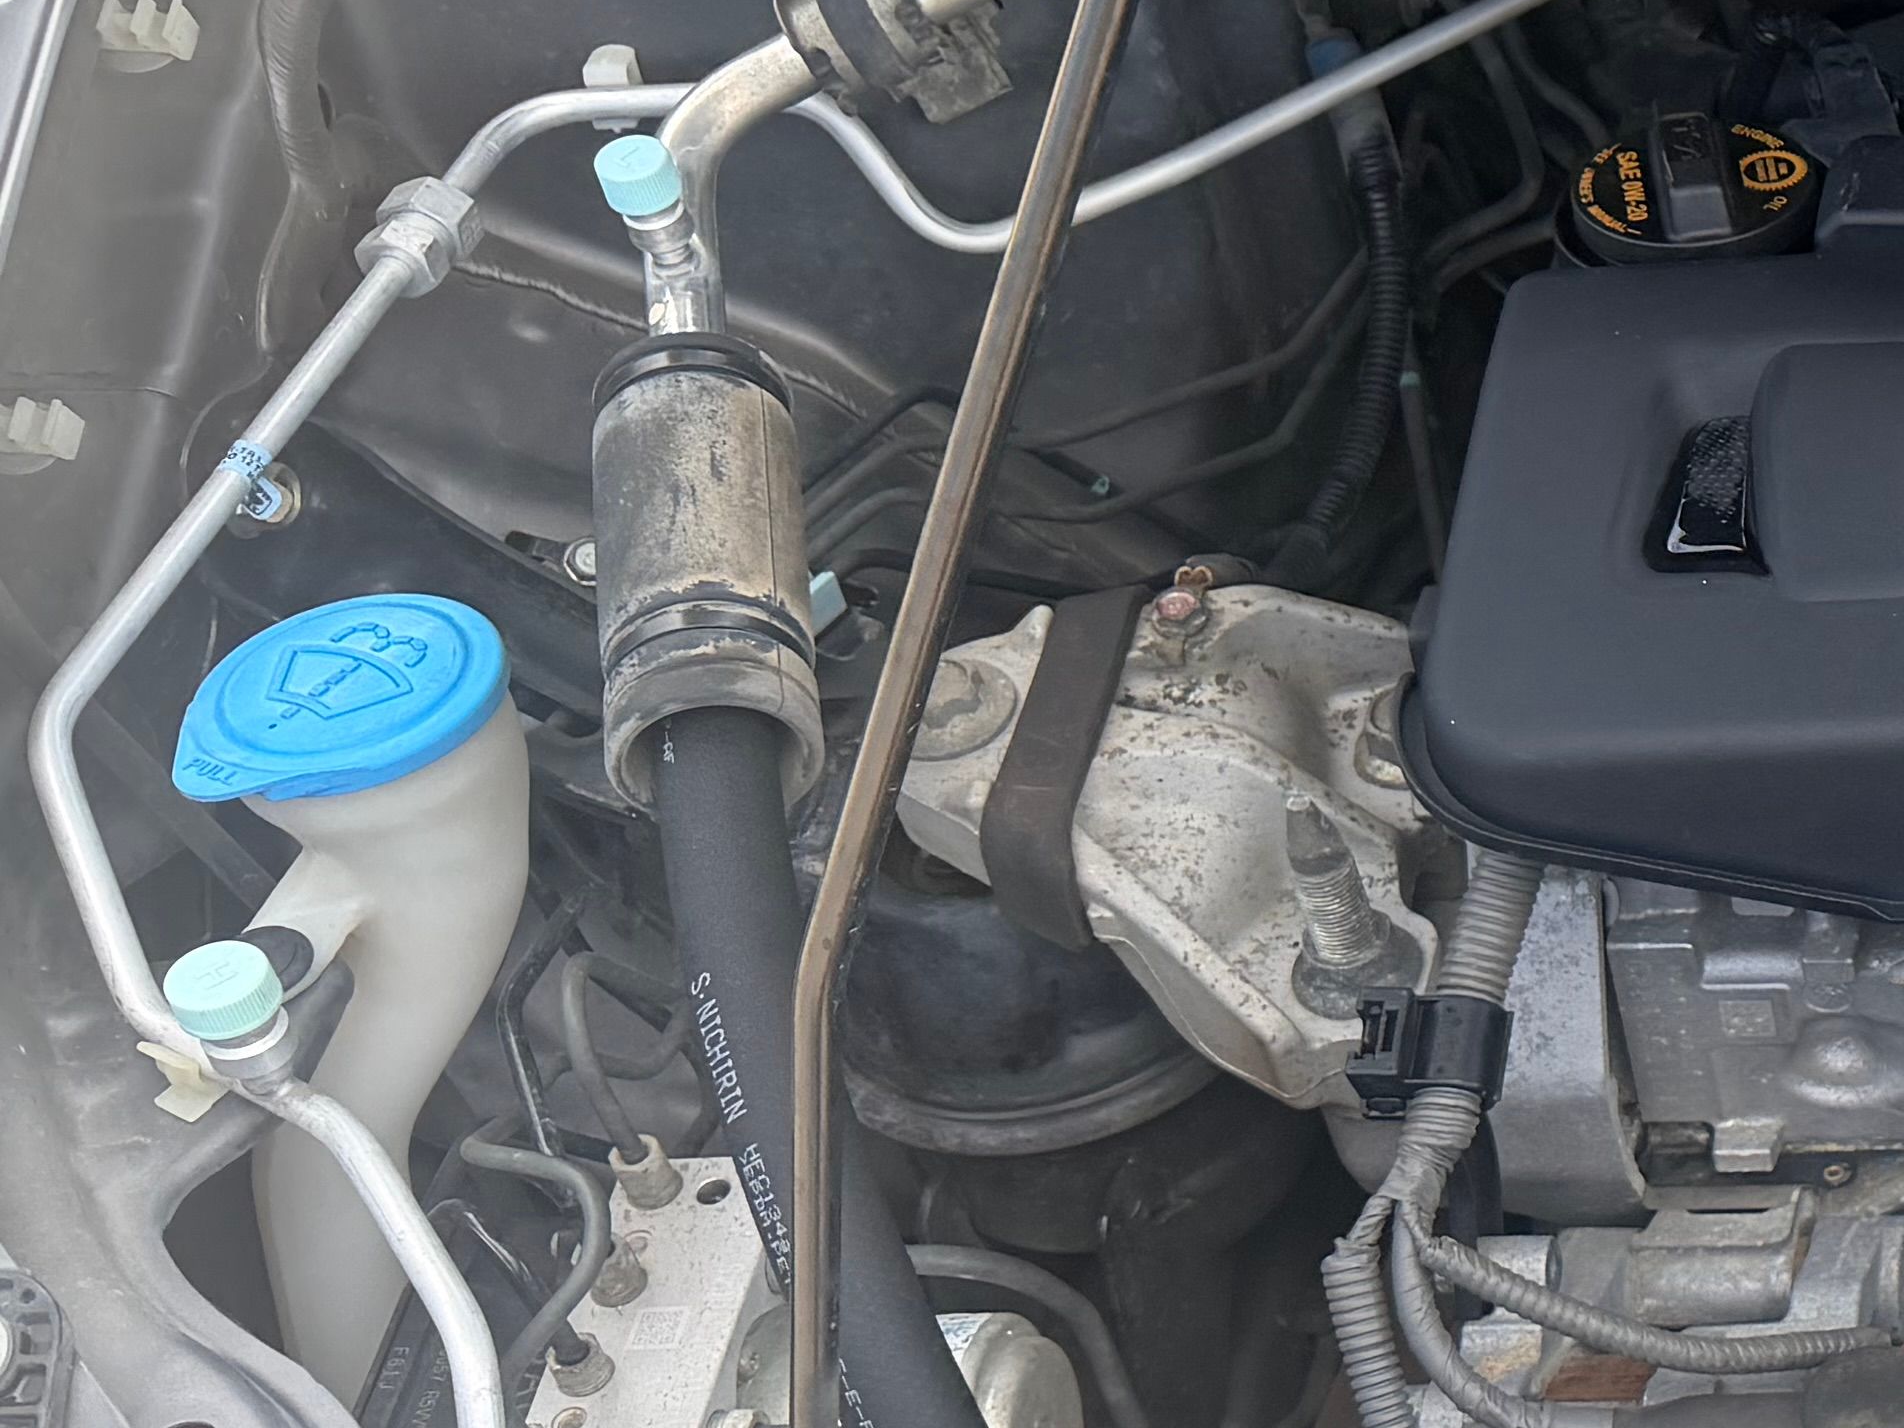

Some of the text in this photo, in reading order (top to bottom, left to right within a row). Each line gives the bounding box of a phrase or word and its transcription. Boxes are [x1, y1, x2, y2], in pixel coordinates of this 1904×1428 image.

[1615, 151, 1642, 180] SAE
[1762, 195, 1788, 212] OIL
[182, 758, 238, 786] PULL
